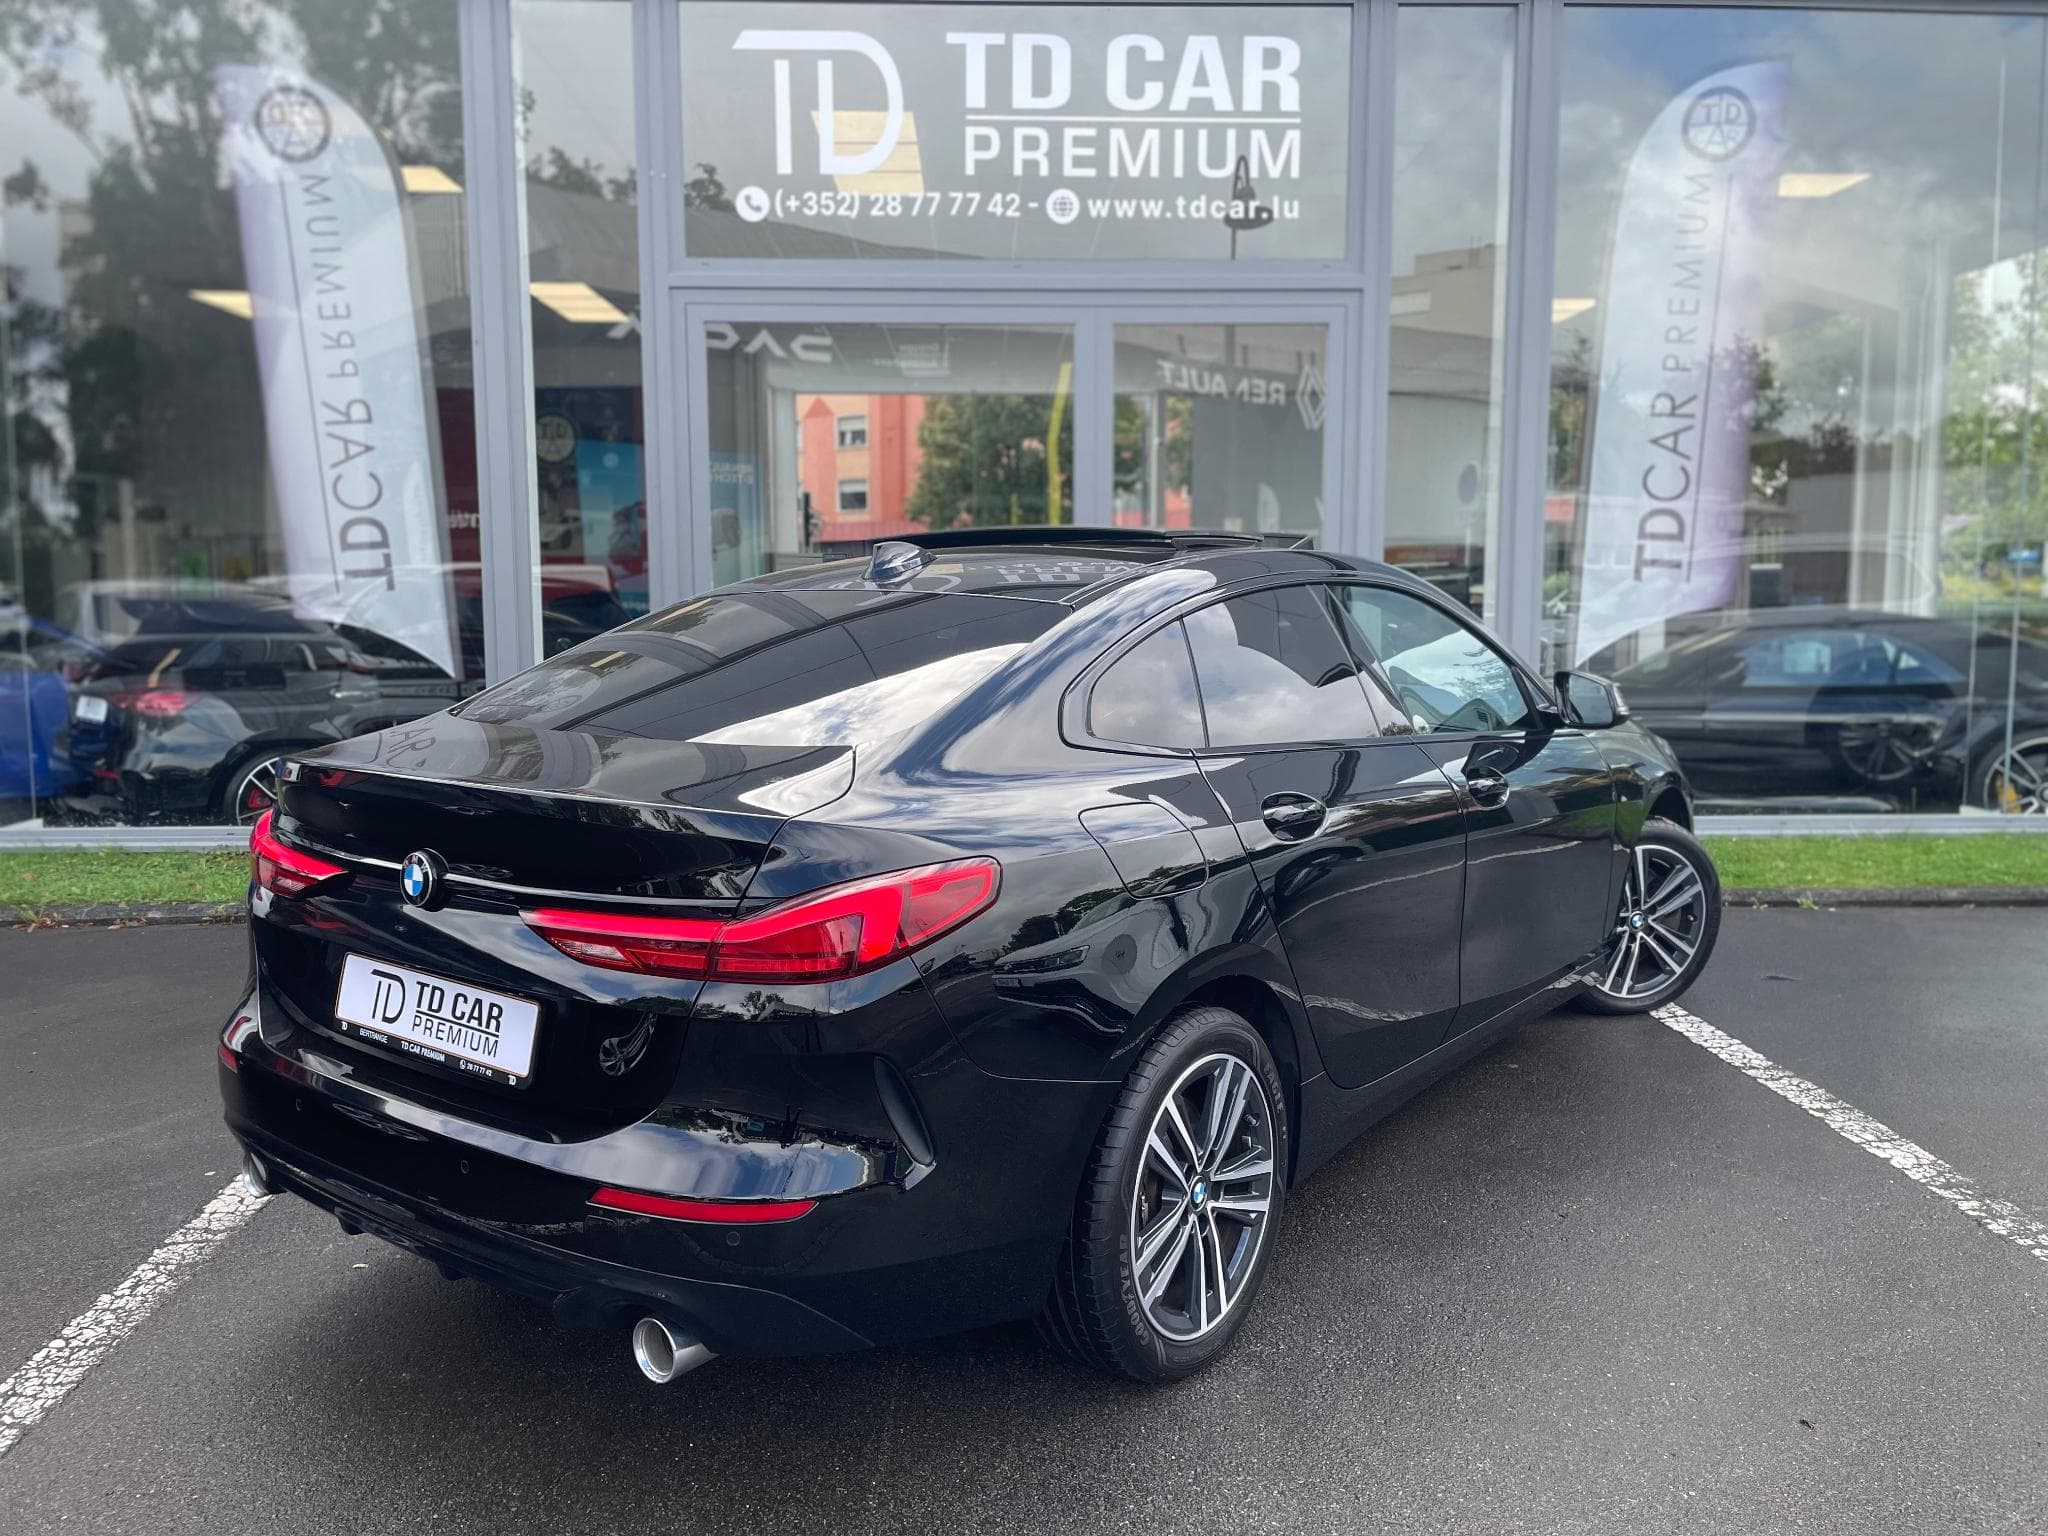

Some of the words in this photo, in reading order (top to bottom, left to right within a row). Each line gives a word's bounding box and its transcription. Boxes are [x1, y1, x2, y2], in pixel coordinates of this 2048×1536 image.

[946, 33, 1072, 110] TD
[1106, 34, 1302, 112] CAR
[964, 126, 1301, 179] PREMIUM
[774, 188, 861, 219] (+352)
[869, 193, 903, 217] 28
[909, 192, 942, 216] 77
[948, 193, 981, 216] 77
[986, 193, 1022, 217] 42
[1087, 194, 1300, 219] www.tdcar.lu
[1662, 170, 1713, 374] PREMIUM
[1634, 392, 1698, 582] TDCAR
[415, 980, 446, 1013] TD
[452, 992, 504, 1033] CAR
[412, 1014, 500, 1058] PREMIUM
